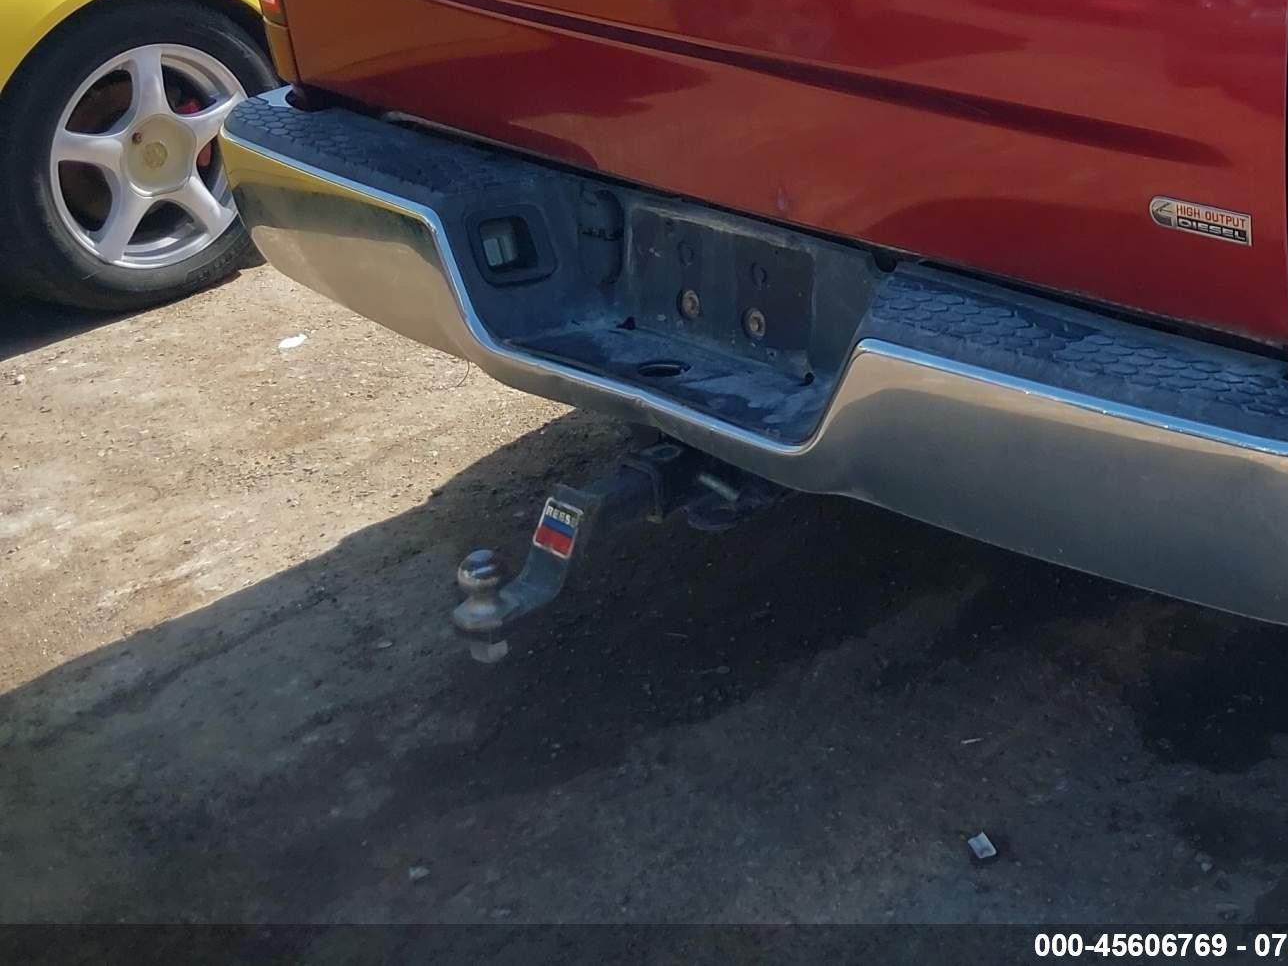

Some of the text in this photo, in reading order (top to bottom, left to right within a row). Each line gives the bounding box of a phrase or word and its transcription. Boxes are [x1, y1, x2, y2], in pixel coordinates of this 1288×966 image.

[1176, 204, 1246, 229] HIGH OUTPUT
[1178, 218, 1246, 241] DIESEL
